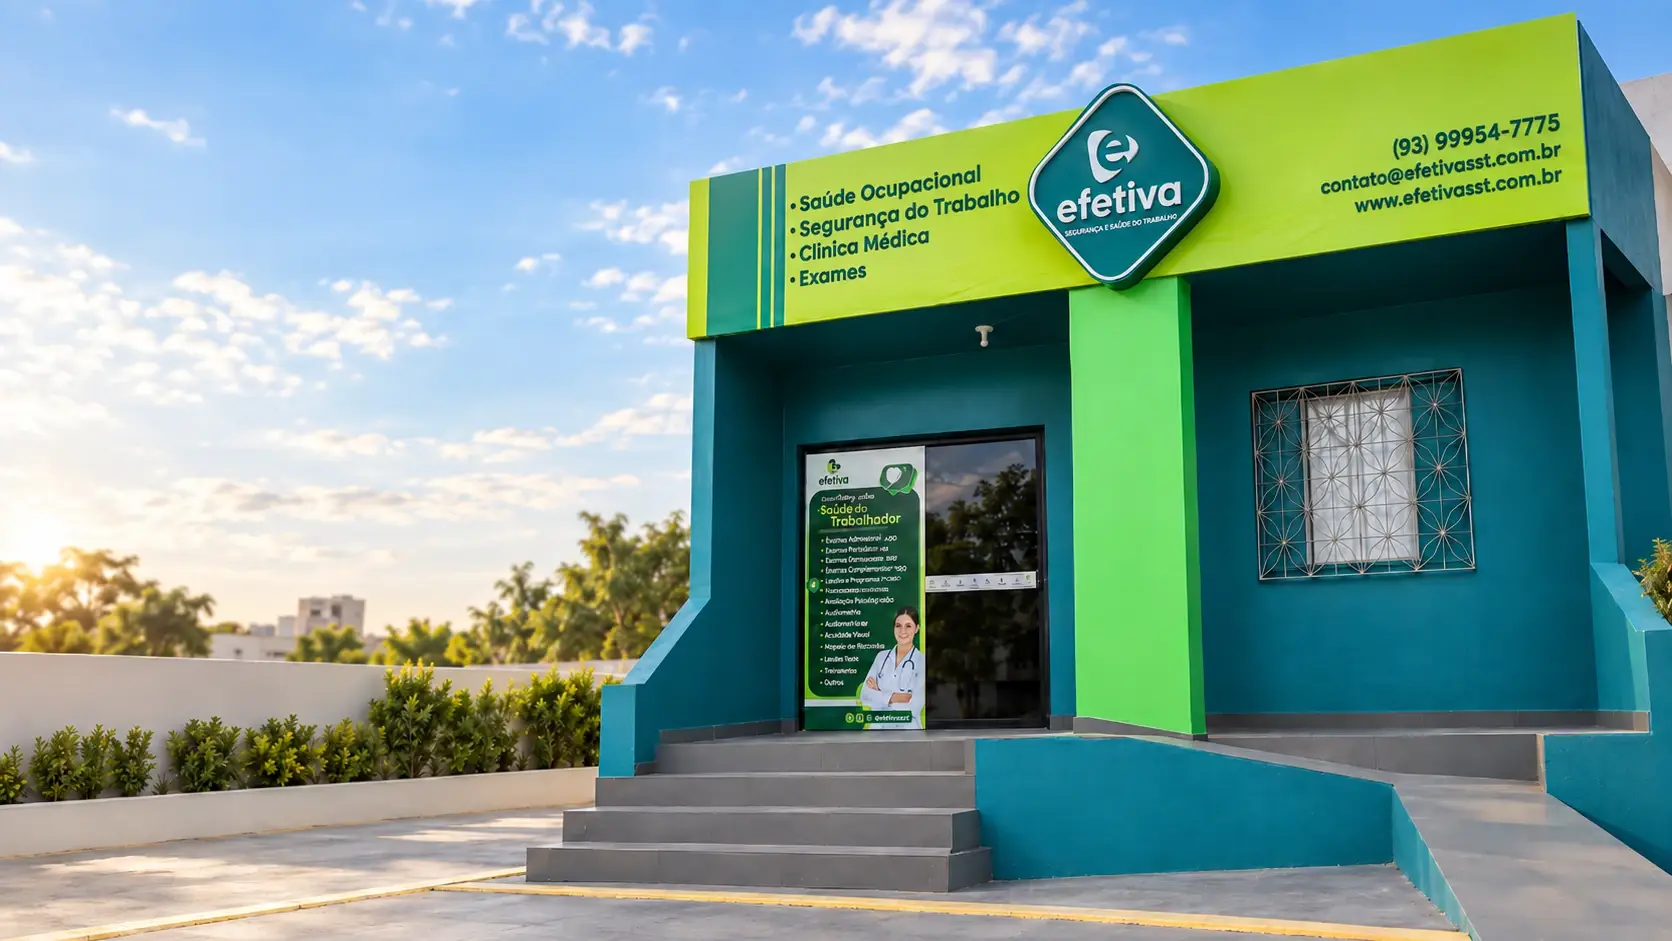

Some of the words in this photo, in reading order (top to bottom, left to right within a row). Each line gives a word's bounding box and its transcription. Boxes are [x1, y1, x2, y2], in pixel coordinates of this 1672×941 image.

[1393, 134, 1429, 160] (93)
[1435, 113, 1561, 150] 99954-7775
[800, 188, 856, 212] Saúde
[860, 164, 981, 201] Ocupacional
[1320, 143, 1561, 194] contato@efetivasst.com.br
[1056, 180, 1182, 224] efetiva
[1354, 168, 1562, 213] www.efetivasst.com.br
[800, 207, 899, 237] Segurança
[905, 202, 928, 220] do
[933, 189, 1020, 215] Trabalho
[1064, 225, 1103, 237] SEGURANÇA
[1110, 220, 1131, 230] SAÚDE
[1143, 214, 1177, 225] TRABALHO
[800, 240, 858, 262] Clinica
[864, 228, 930, 252] Médica
[800, 264, 866, 286] Exames
[818, 475, 849, 486] efetiva
[820, 504, 852, 515] Saúde
[855, 504, 868, 513] do
[830, 513, 902, 527] Trabalhador
